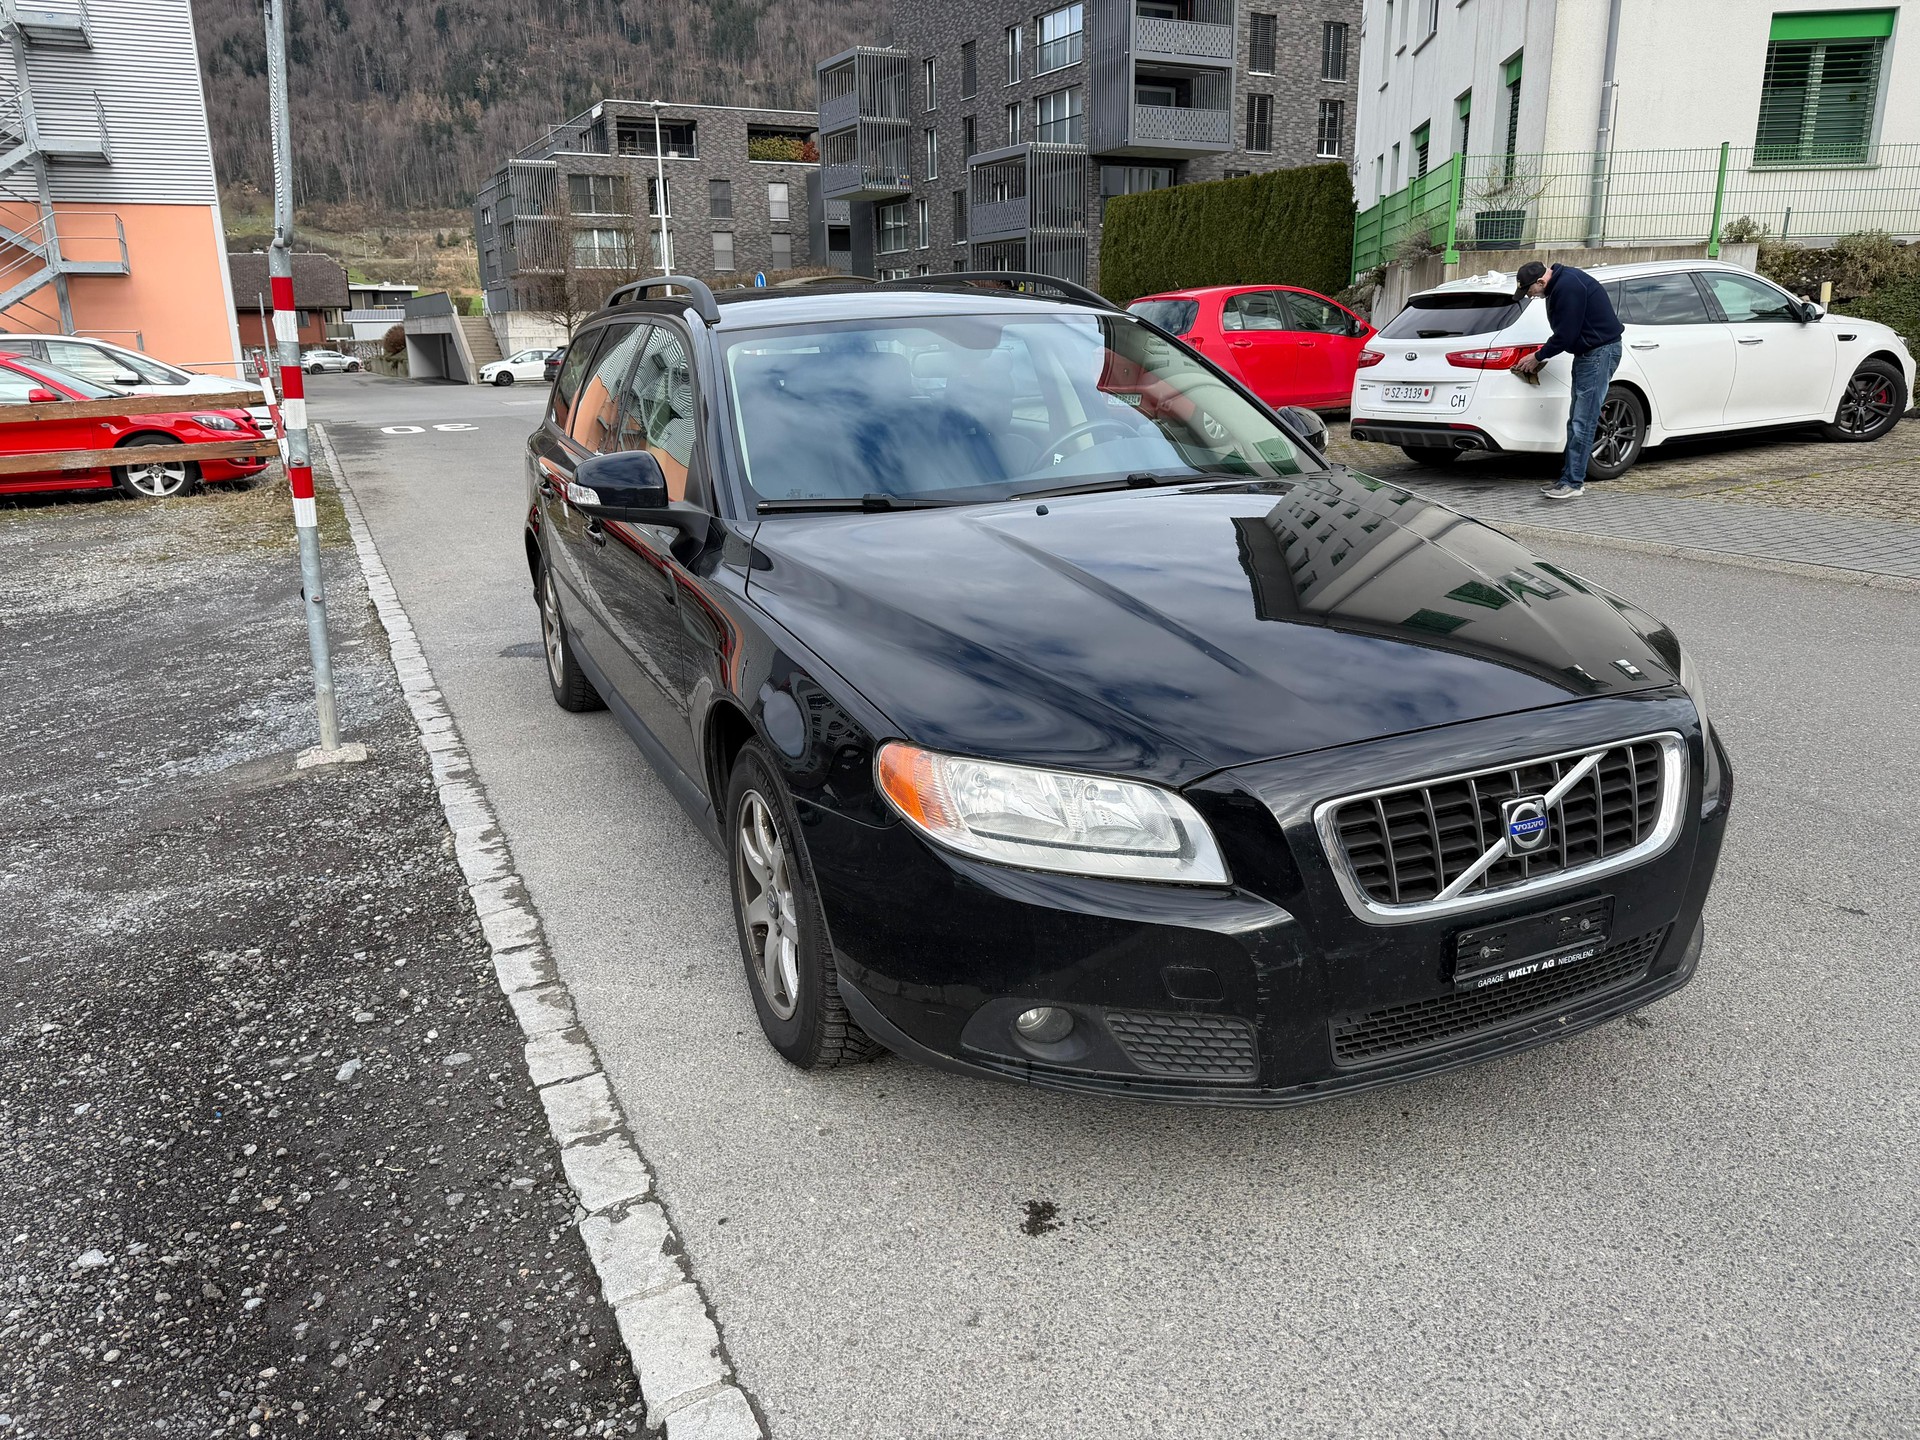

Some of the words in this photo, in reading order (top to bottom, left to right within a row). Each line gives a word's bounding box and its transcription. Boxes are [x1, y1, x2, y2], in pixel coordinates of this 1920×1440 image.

[1451, 395, 1467, 408] CH
[1513, 820, 1544, 832] VOLVO
[1477, 974, 1504, 988] GARAGE
[1541, 959, 1555, 970] AG
[1558, 949, 1594, 965] NIEDERLENZ
